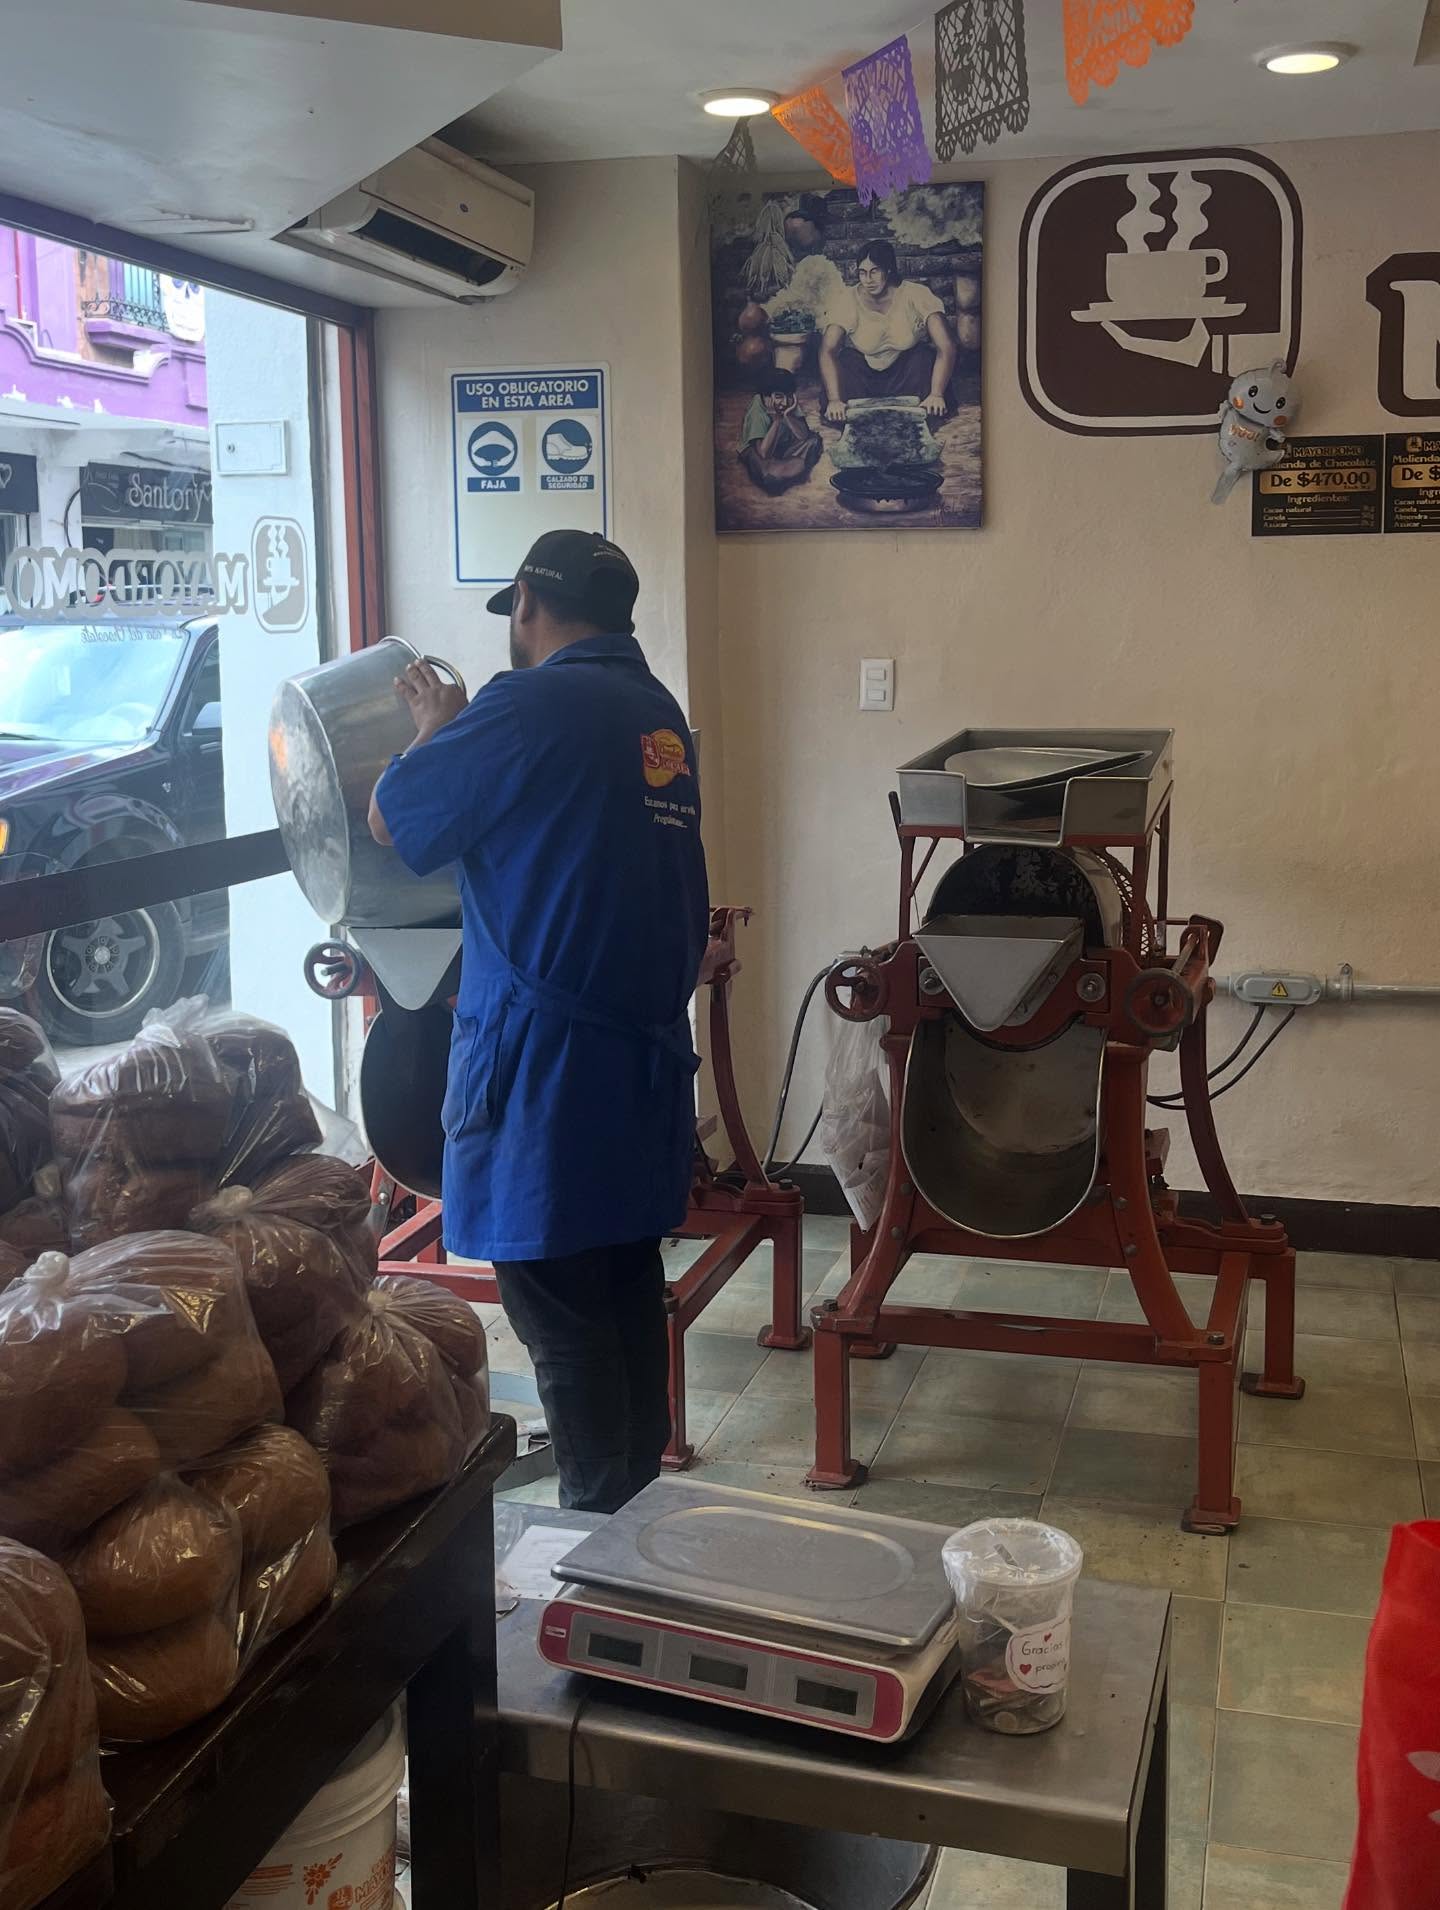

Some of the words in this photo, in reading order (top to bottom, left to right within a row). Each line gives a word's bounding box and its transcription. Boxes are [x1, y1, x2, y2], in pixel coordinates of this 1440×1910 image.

[466, 382, 493, 396] USO
[499, 379, 589, 394] OBLIGATORIO
[481, 396, 500, 408] EN
[504, 396, 534, 408] ESTA
[538, 394, 574, 407] AREA
[1309, 460, 1323, 469] de
[1325, 458, 1376, 469] Chocolate
[1271, 474, 1292, 487] De
[1297, 471, 1370, 488] $470.00
[1402, 467, 1423, 481] De
[480, 480, 507, 490] FAJA
[1021, 1640, 1064, 1656] Gracias
